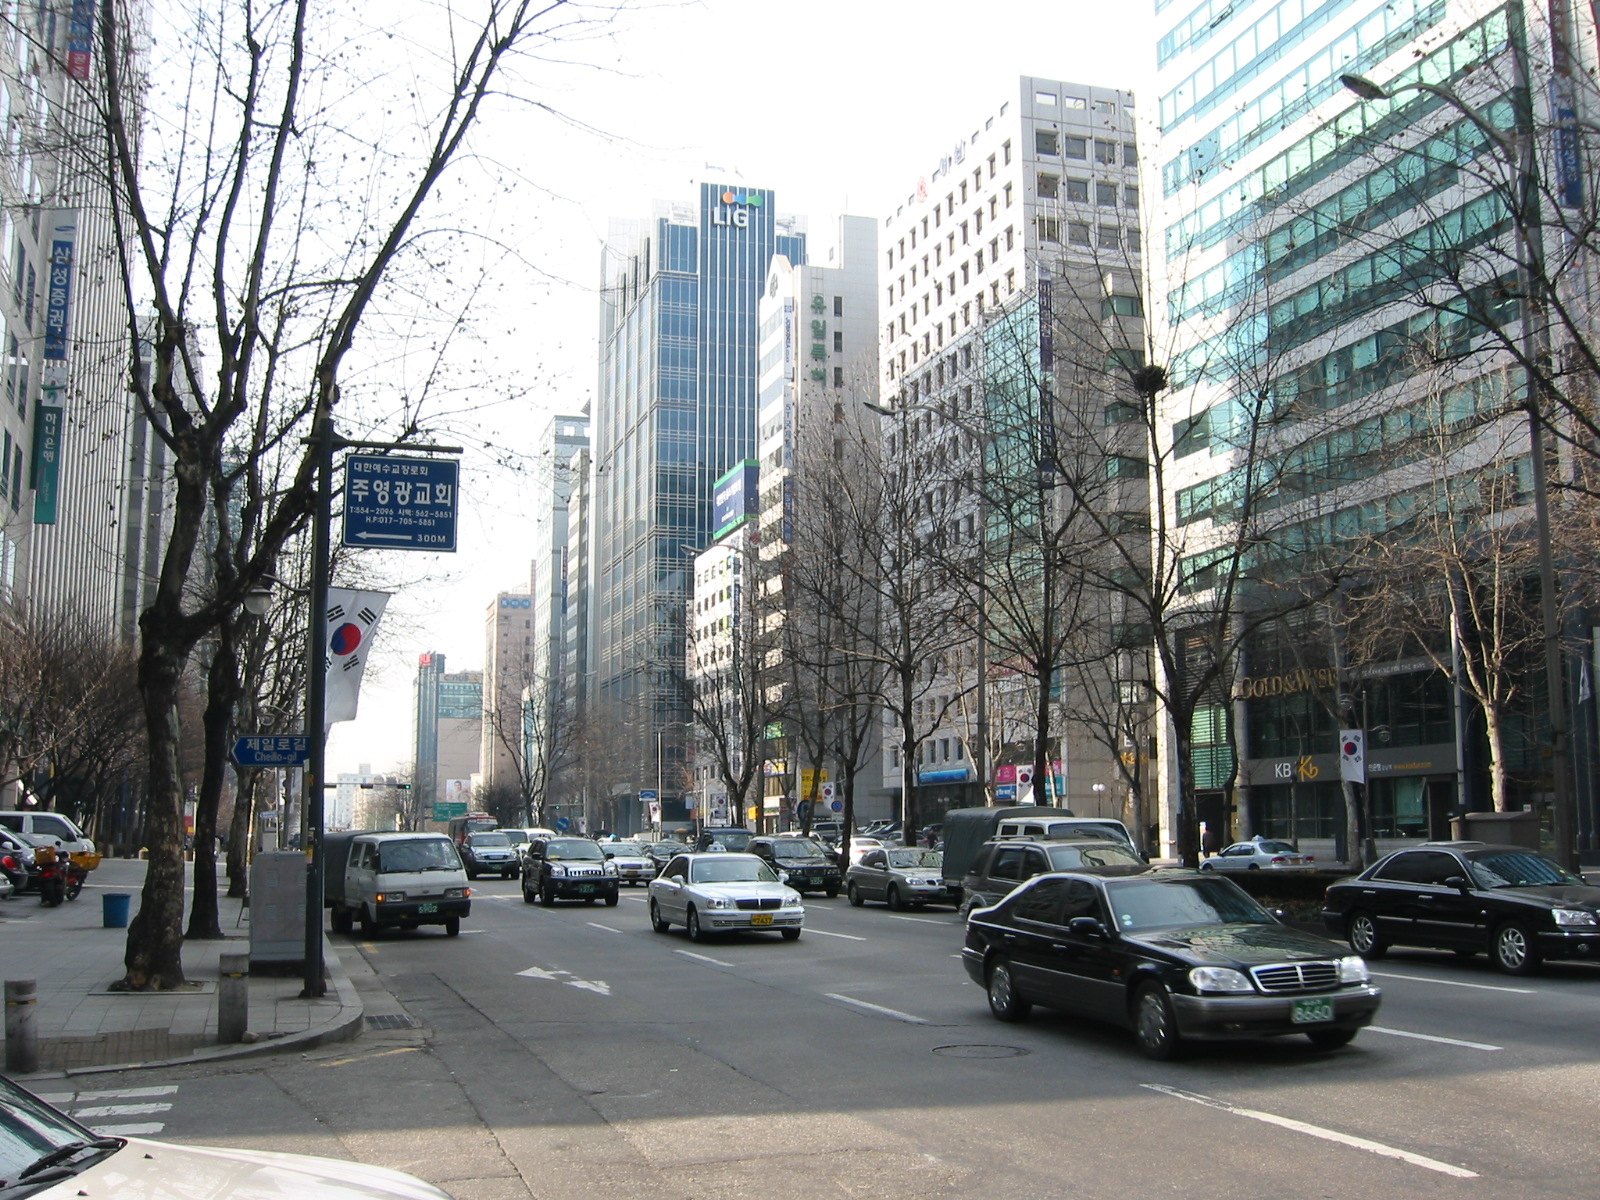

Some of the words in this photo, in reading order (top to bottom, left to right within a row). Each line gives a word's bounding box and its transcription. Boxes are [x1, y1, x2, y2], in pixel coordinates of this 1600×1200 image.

[713, 206, 749, 228] LIG
[50, 246, 70, 328] 삼성증권
[43, 413, 57, 463] 하나은행
[353, 462, 429, 476] 대한예수교장로회
[352, 479, 452, 507] 주영광교회
[417, 534, 446, 543] 300M
[246, 738, 306, 751] 제일로길
[1274, 762, 1292, 778] KB
[1294, 1005, 1333, 1022] 8660
